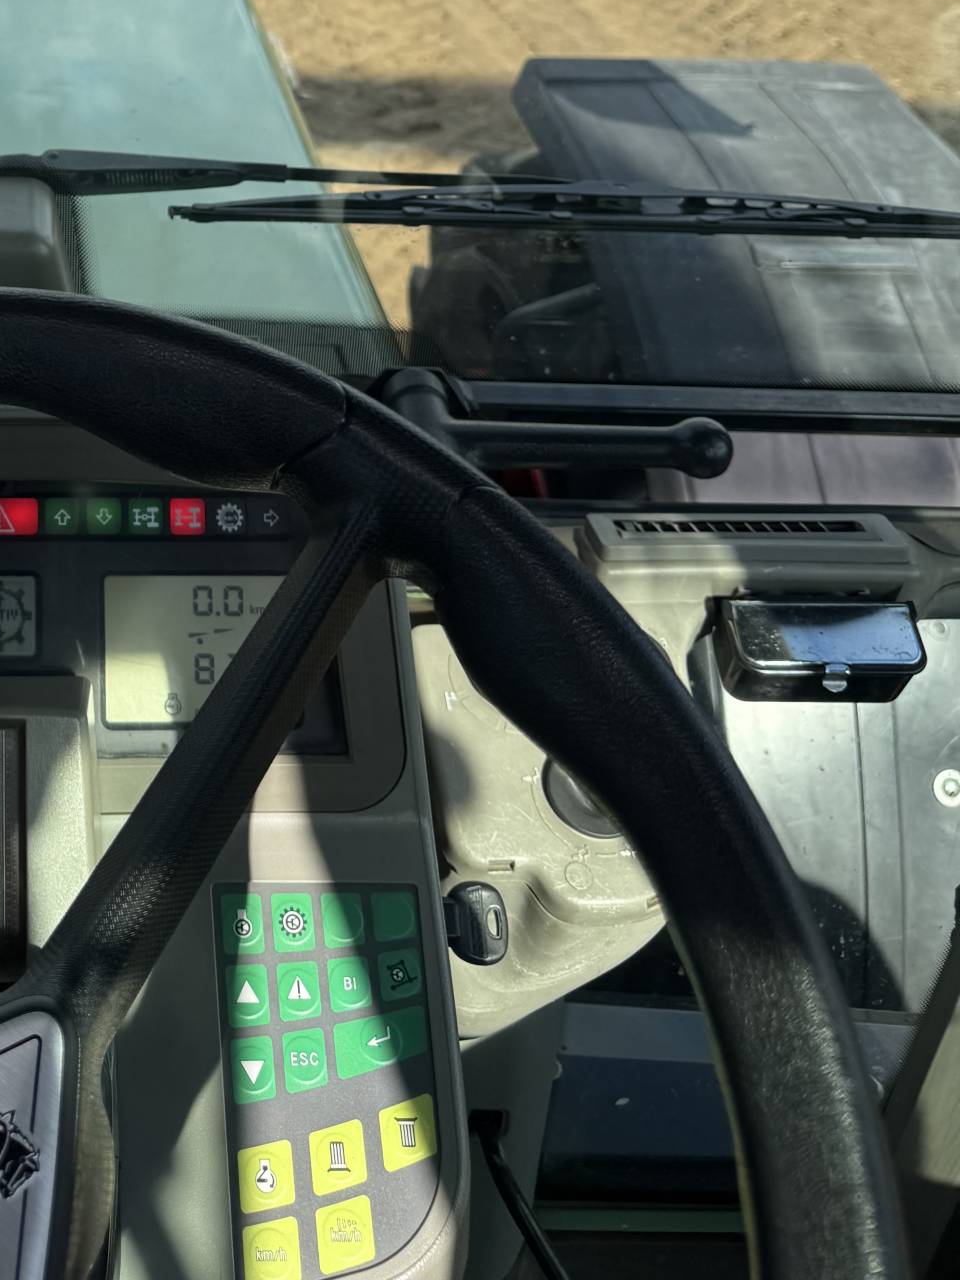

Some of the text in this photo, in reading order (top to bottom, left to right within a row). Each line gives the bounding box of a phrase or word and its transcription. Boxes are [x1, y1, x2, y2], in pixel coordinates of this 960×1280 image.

[192, 585, 244, 617] 0.0
[290, 1051, 319, 1067] ESC
[255, 1246, 288, 1262] km/h
